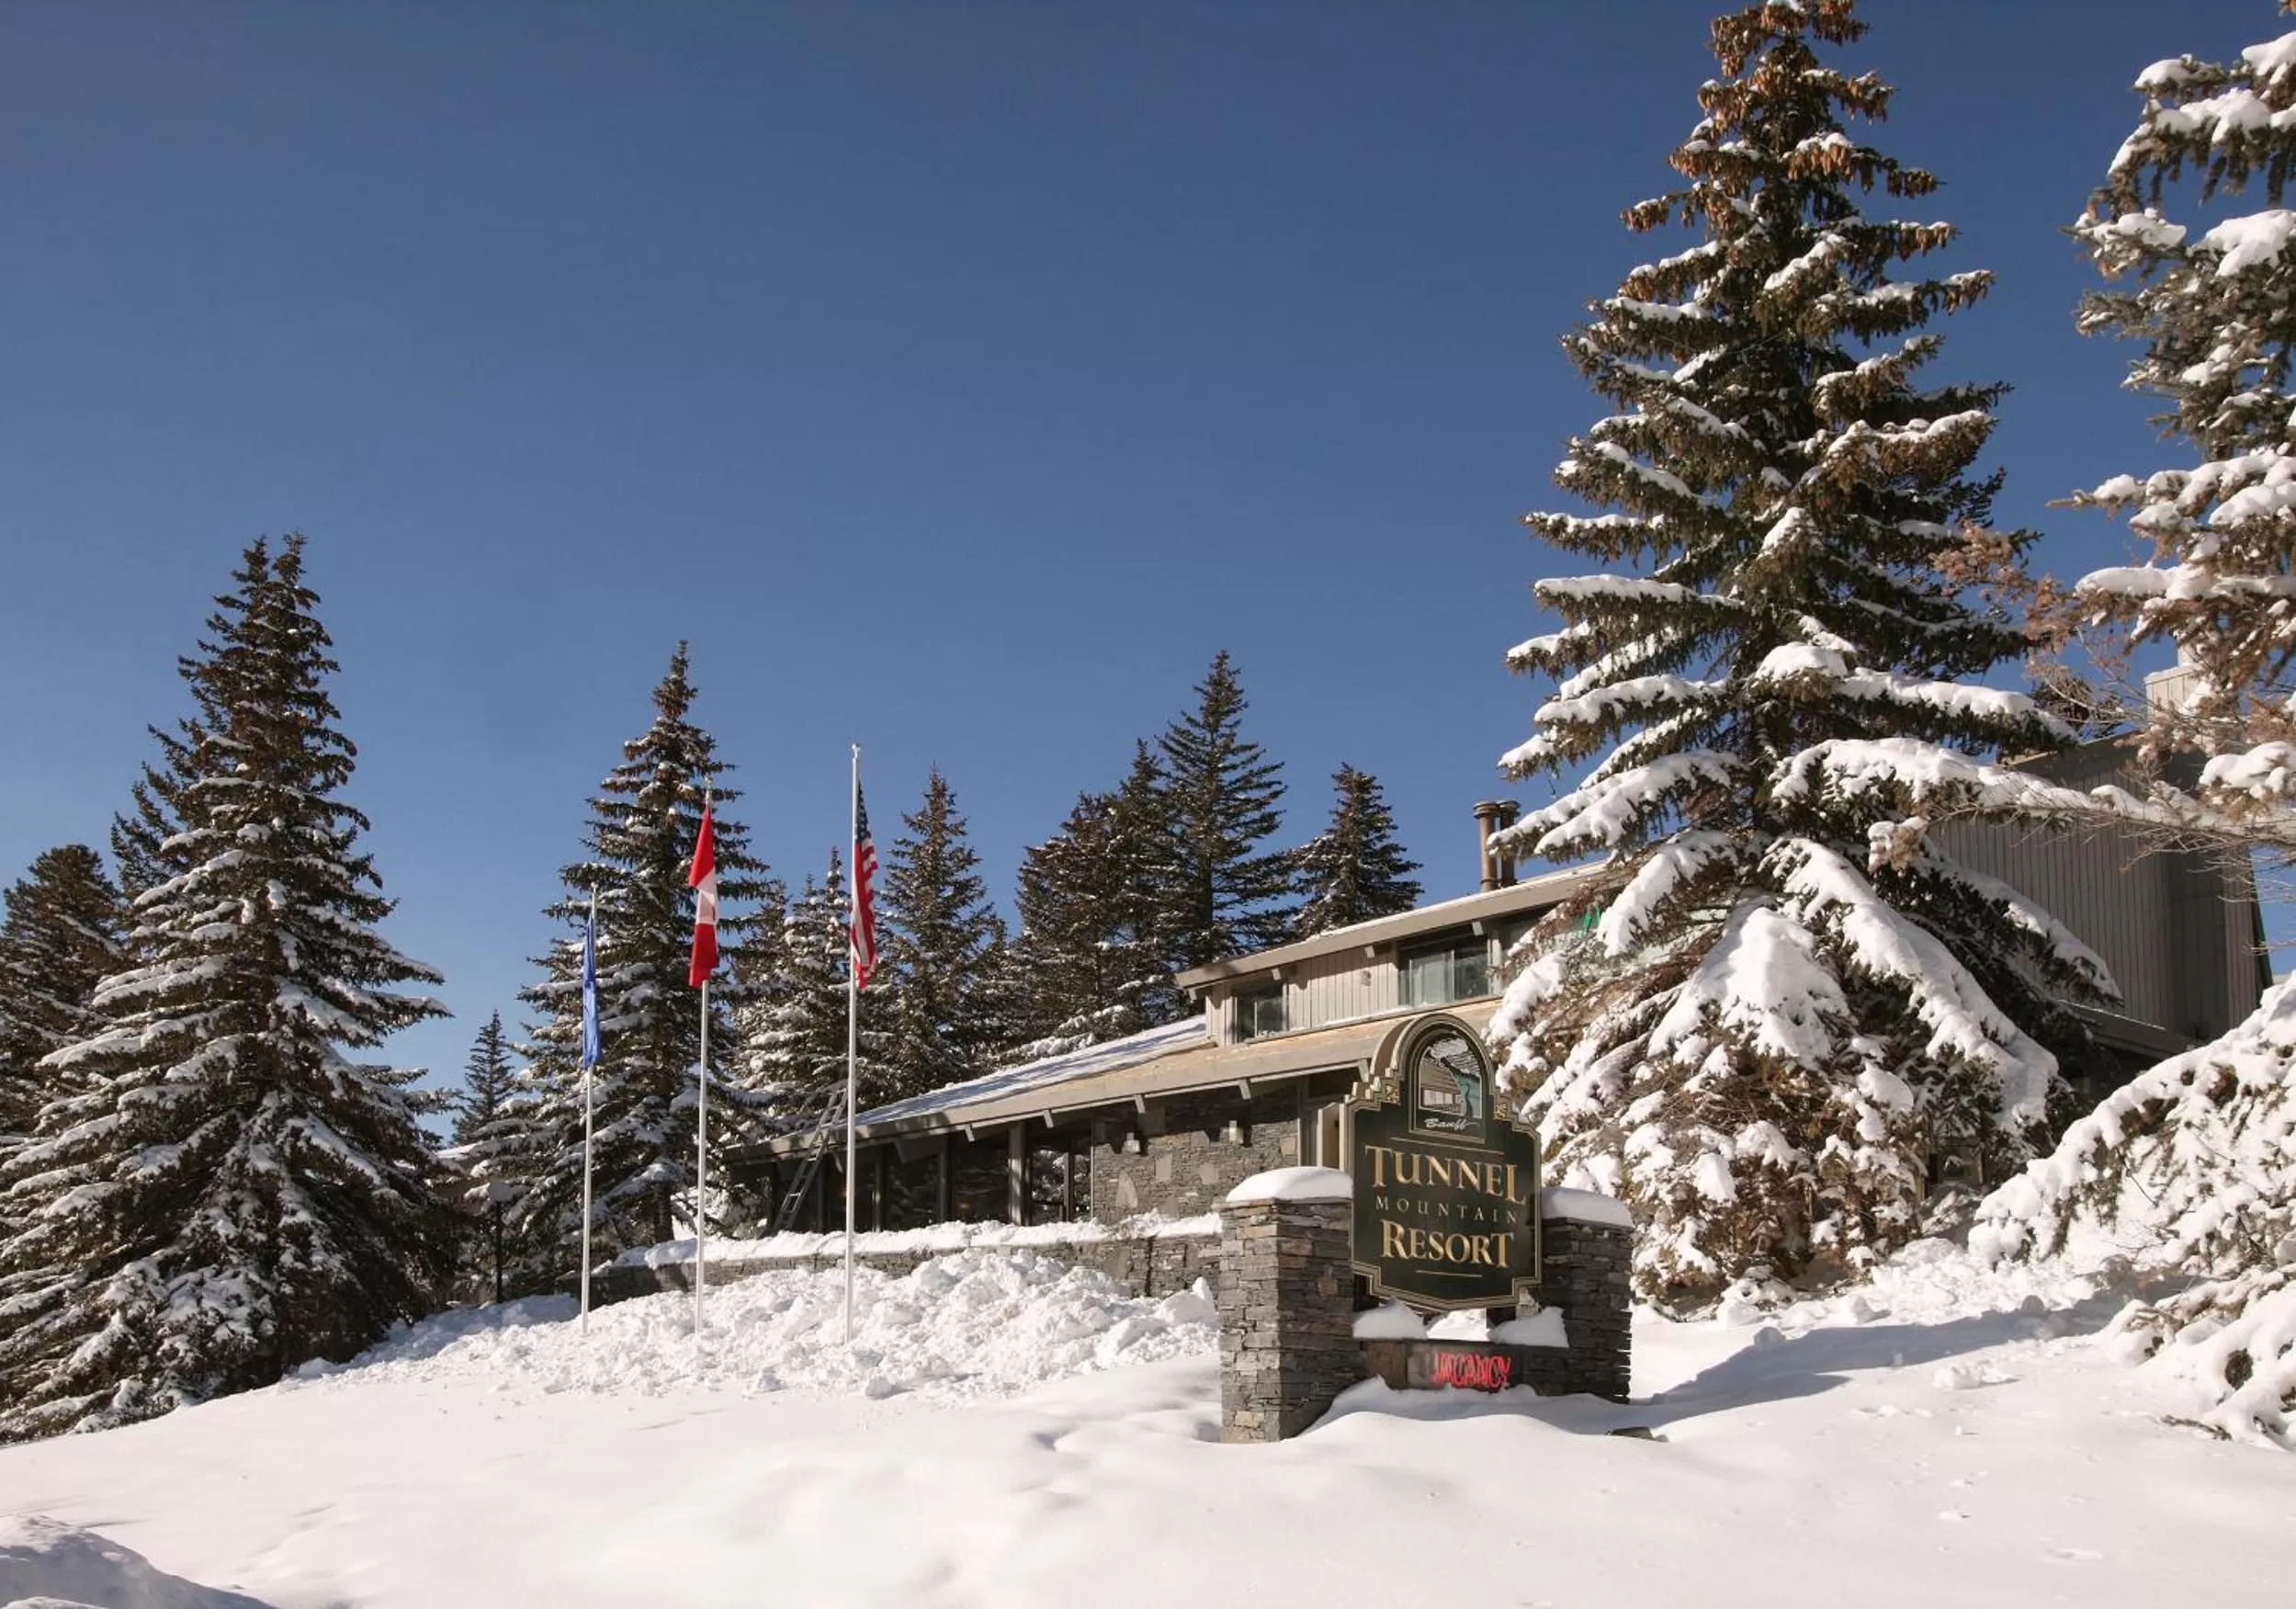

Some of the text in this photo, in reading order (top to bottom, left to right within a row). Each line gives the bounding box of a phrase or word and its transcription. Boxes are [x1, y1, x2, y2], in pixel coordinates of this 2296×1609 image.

[1424, 1117, 1472, 1131] Banff
[1365, 1145, 1525, 1206] TUNNEL
[1375, 1195, 1517, 1224] MOUNTAIN
[1380, 1219, 1514, 1267] RESORT
